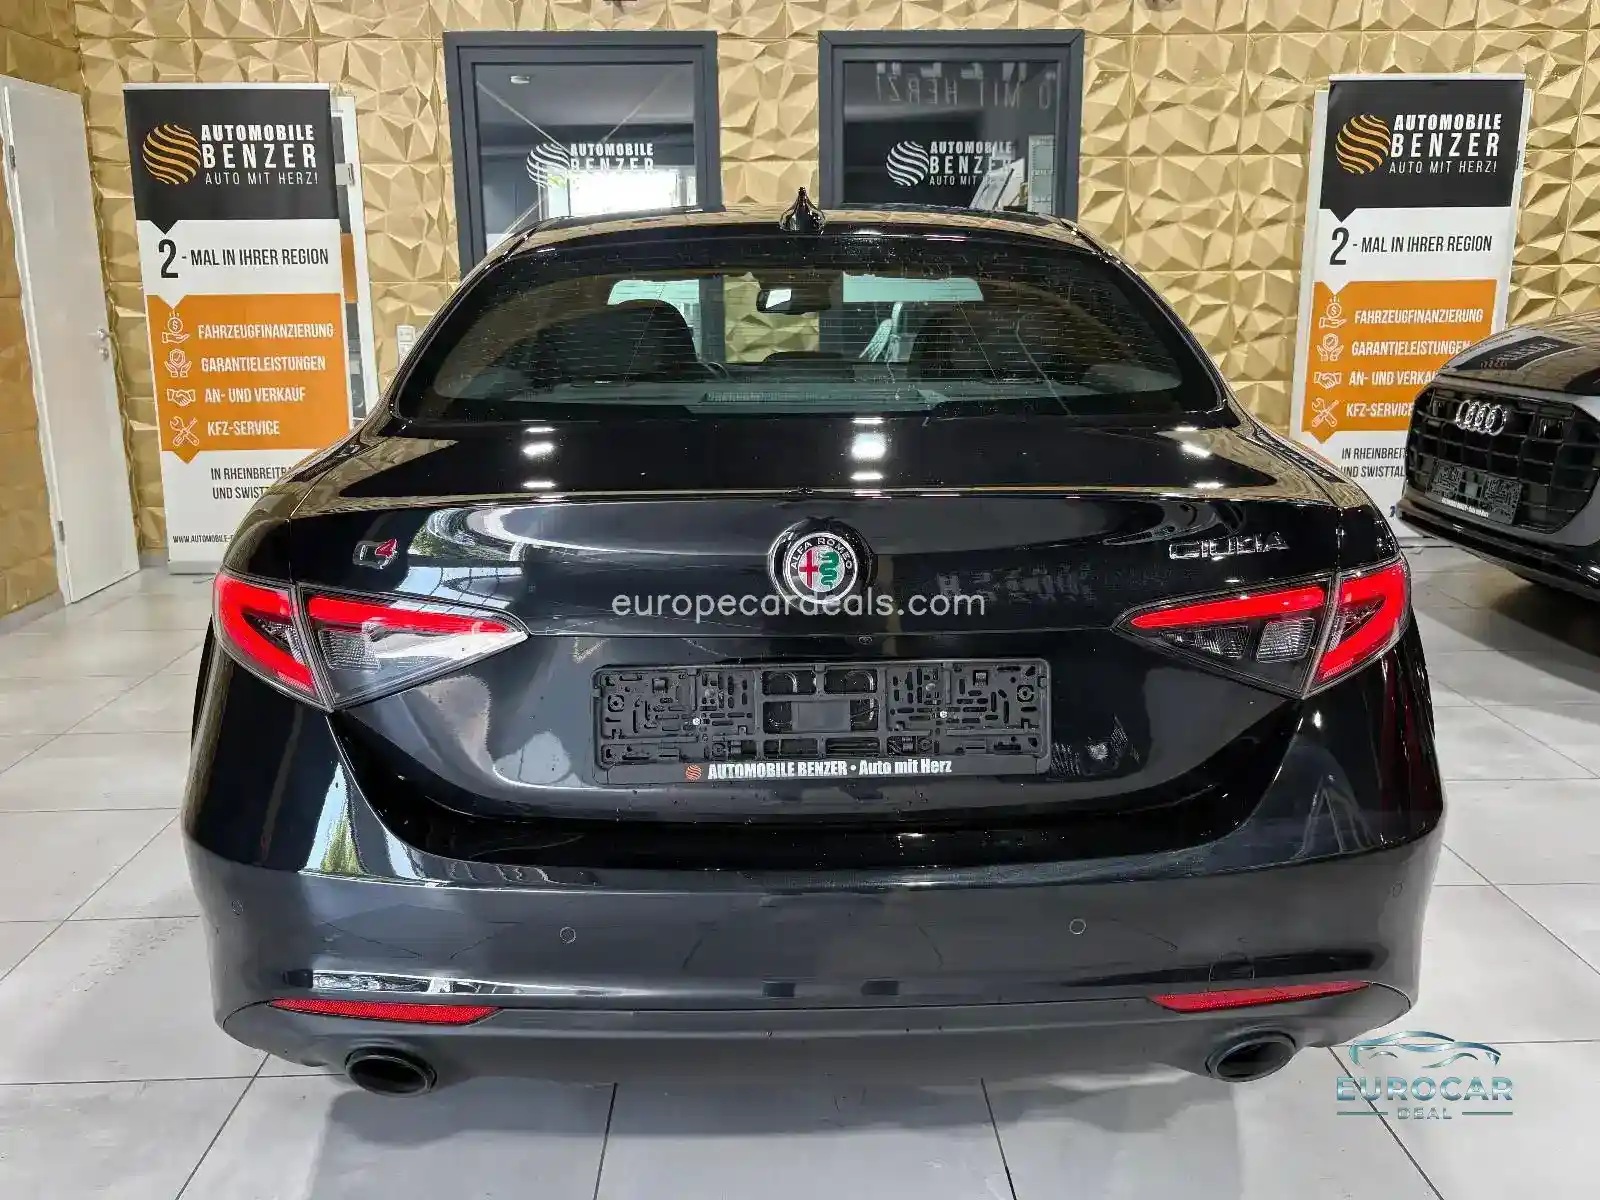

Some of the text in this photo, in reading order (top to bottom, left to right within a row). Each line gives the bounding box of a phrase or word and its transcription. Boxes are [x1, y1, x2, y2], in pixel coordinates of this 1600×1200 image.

[1393, 113, 1502, 131] AUTOMOBILE
[201, 124, 315, 142] AUTOMOBILE
[570, 143, 654, 156] AUTOMOBILE
[930, 141, 1012, 154] AUTOMOBILE
[1390, 132, 1499, 158] BENZER
[203, 143, 317, 169] BENZER
[1389, 160, 1497, 174] AUTO MIT HERZ!
[205, 172, 319, 185] AUTO MIT HERZ!
[930, 176, 955, 186] AUTO
[960, 176, 977, 186] MIT
[1329, 227, 1350, 266] 2
[1361, 237, 1388, 253] MAL
[1390, 237, 1404, 252] IN
[1406, 236, 1444, 252] IHRER
[1446, 235, 1492, 251] REGION
[158, 239, 179, 279] 2
[190, 250, 220, 266] MAL
[222, 249, 236, 266] IN
[239, 249, 279, 265] IHRER
[282, 248, 329, 265] REGION
[1354, 309, 1484, 324] FAHRZEUGFINANZIERUNG
[198, 323, 334, 340] FAHRZEUGFINANZIERUNG
[201, 355, 326, 372] GARANTIELEISTUNGEN
[1348, 371, 1369, 386] AN-
[1371, 371, 1394, 386] UND
[204, 387, 306, 403] AN- UND VERKAUF
[207, 420, 280, 437] KFZ-SERVICE
[1341, 447, 1351, 459] IN
[210, 468, 221, 480] IN
[1360, 465, 1405, 478] SWISTTAL
[212, 486, 233, 499] UND
[790, 537, 853, 570] ALFA ROMEO
[707, 758, 952, 780] AUTOMOBILE BENZER Auto mit Herz
